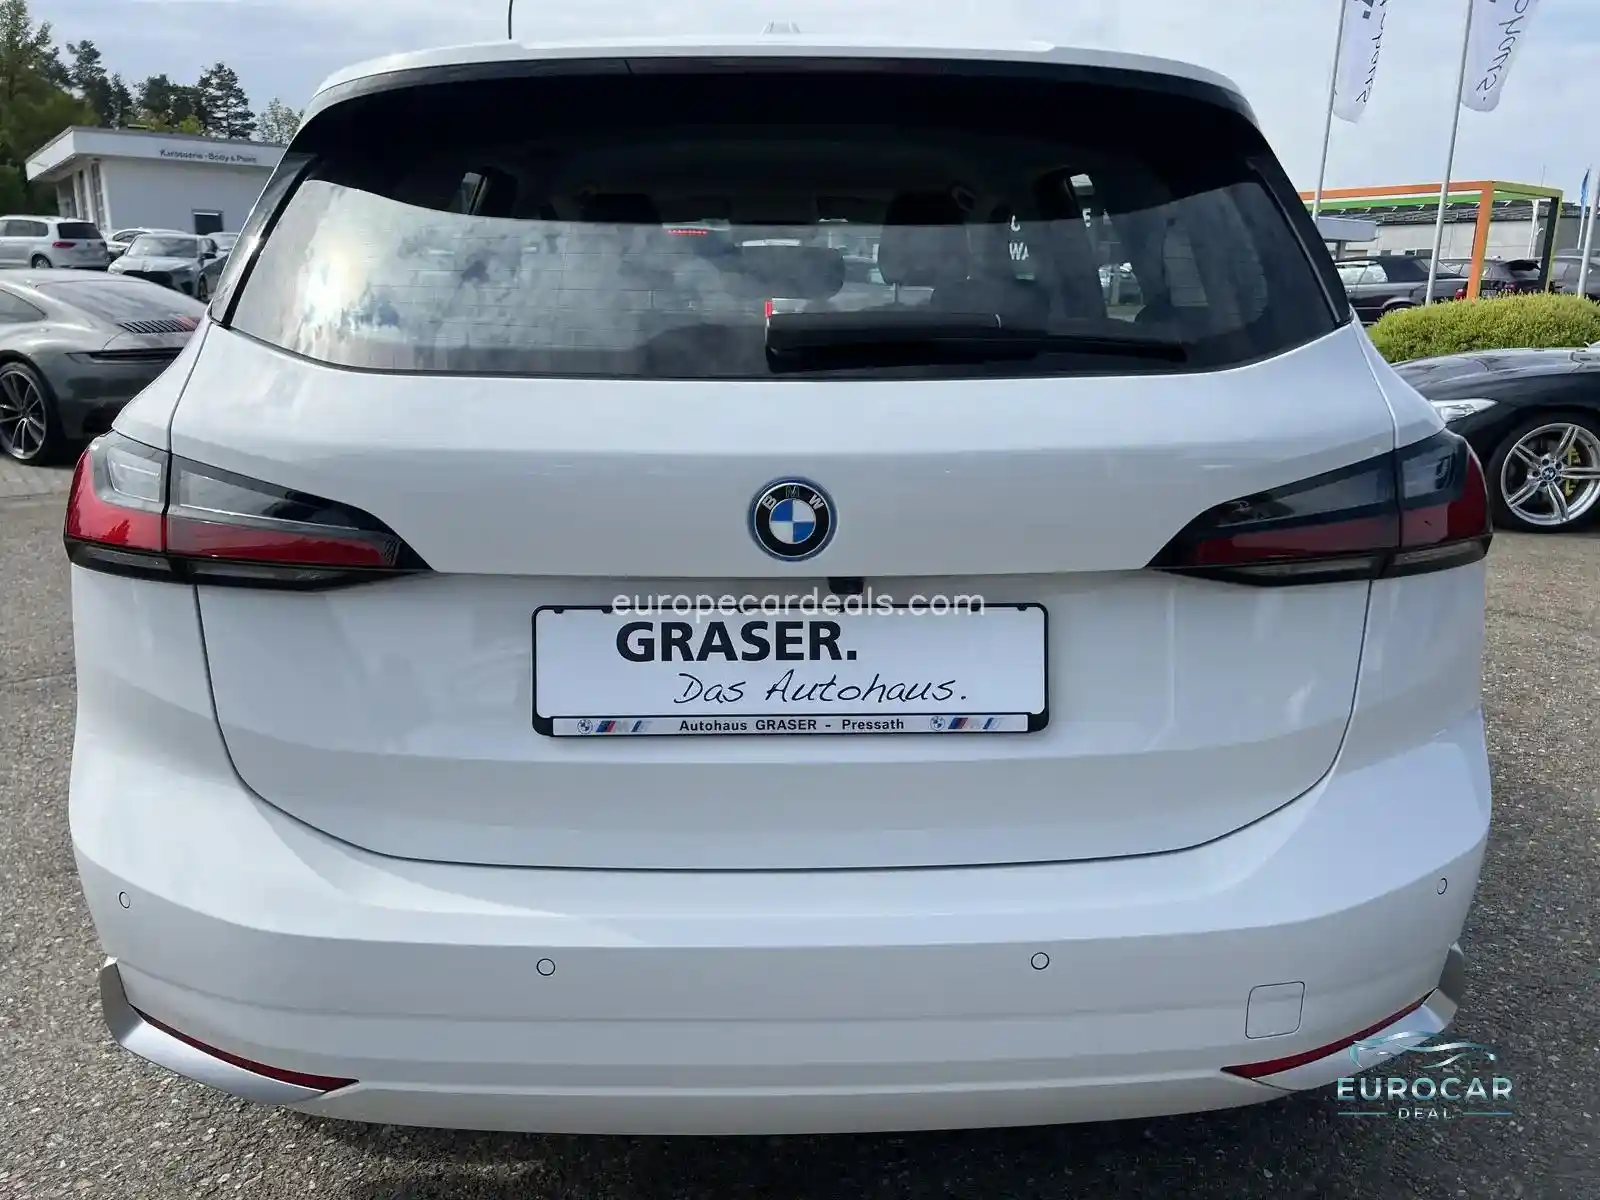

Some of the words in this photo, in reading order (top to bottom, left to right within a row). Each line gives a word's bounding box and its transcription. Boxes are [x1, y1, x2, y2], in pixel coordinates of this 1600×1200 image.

[762, 485, 824, 510] BMW
[616, 620, 858, 662] GRASER.
[673, 672, 745, 704] Das
[765, 669, 967, 704] Autohaus.
[679, 719, 748, 733] Autohaus
[755, 719, 817, 732] GRASER
[841, 718, 905, 731] Pressath
